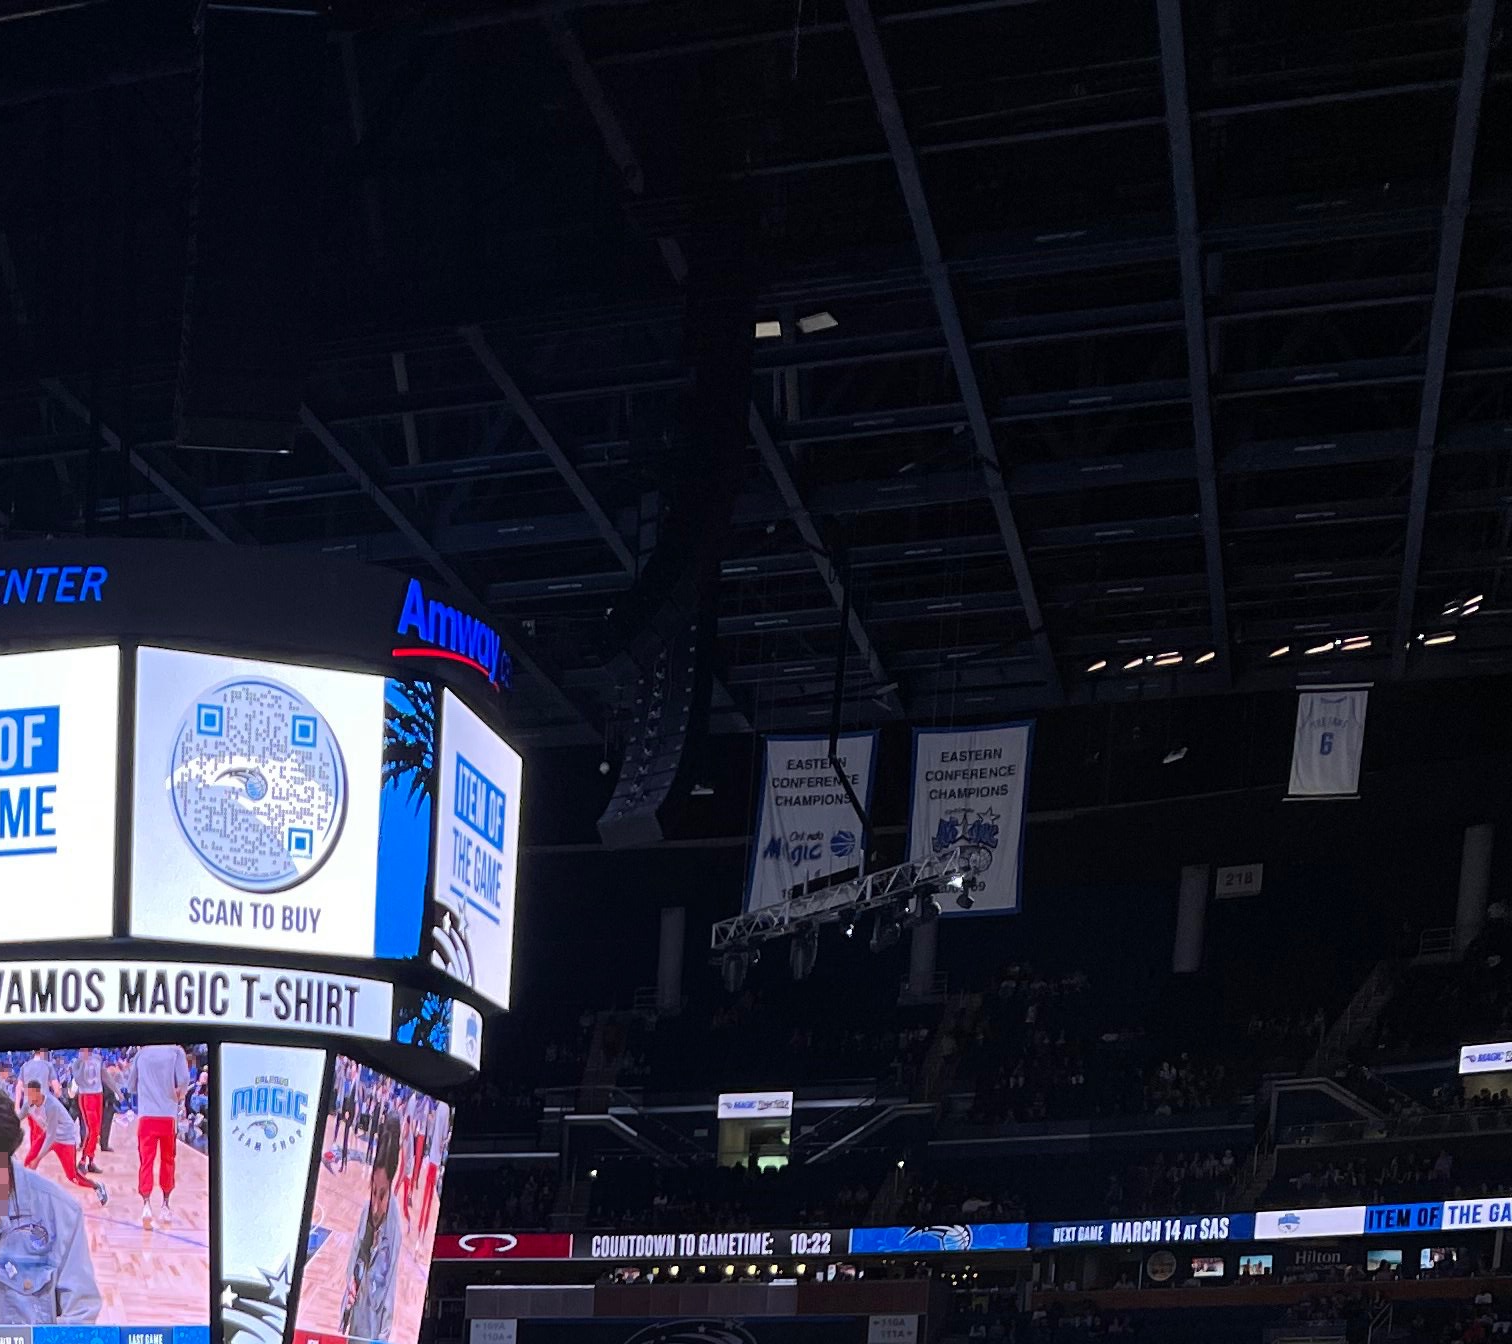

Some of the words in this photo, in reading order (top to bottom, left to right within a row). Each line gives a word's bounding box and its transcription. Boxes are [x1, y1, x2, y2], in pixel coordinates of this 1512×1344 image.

[397, 577, 500, 684] Amway
[941, 748, 1002, 763] EASTERN
[1320, 732, 1334, 756] 6
[925, 764, 1016, 782] CONFERENCE
[457, 762, 487, 831] ITEM
[488, 789, 504, 844] OF
[929, 784, 1008, 800] CHAMPIONS
[453, 827, 472, 888] THE
[474, 845, 502, 909] GAME
[189, 896, 243, 927] SCAN
[250, 902, 275, 930] TO
[281, 905, 321, 933] BUY
[118, 968, 230, 1016] MAGIC
[240, 974, 360, 1029] T-SHIRT
[231, 1085, 308, 1125] MAGIC
[272, 1129, 303, 1153] SHOP
[1369, 1208, 1411, 1230] ITEM
[1417, 1206, 1438, 1227] OF
[1448, 1204, 1483, 1225] THE
[1110, 1221, 1161, 1244] MARCH
[1164, 1219, 1181, 1241] 14
[1183, 1225, 1197, 1240] AT
[1199, 1217, 1229, 1240] SAS
[591, 1233, 675, 1258] COUNTDOWN
[678, 1233, 696, 1256] TO
[698, 1232, 774, 1256] GAMETIME:
[789, 1232, 832, 1254] 10:22
[1294, 1250, 1341, 1265] Hilton
